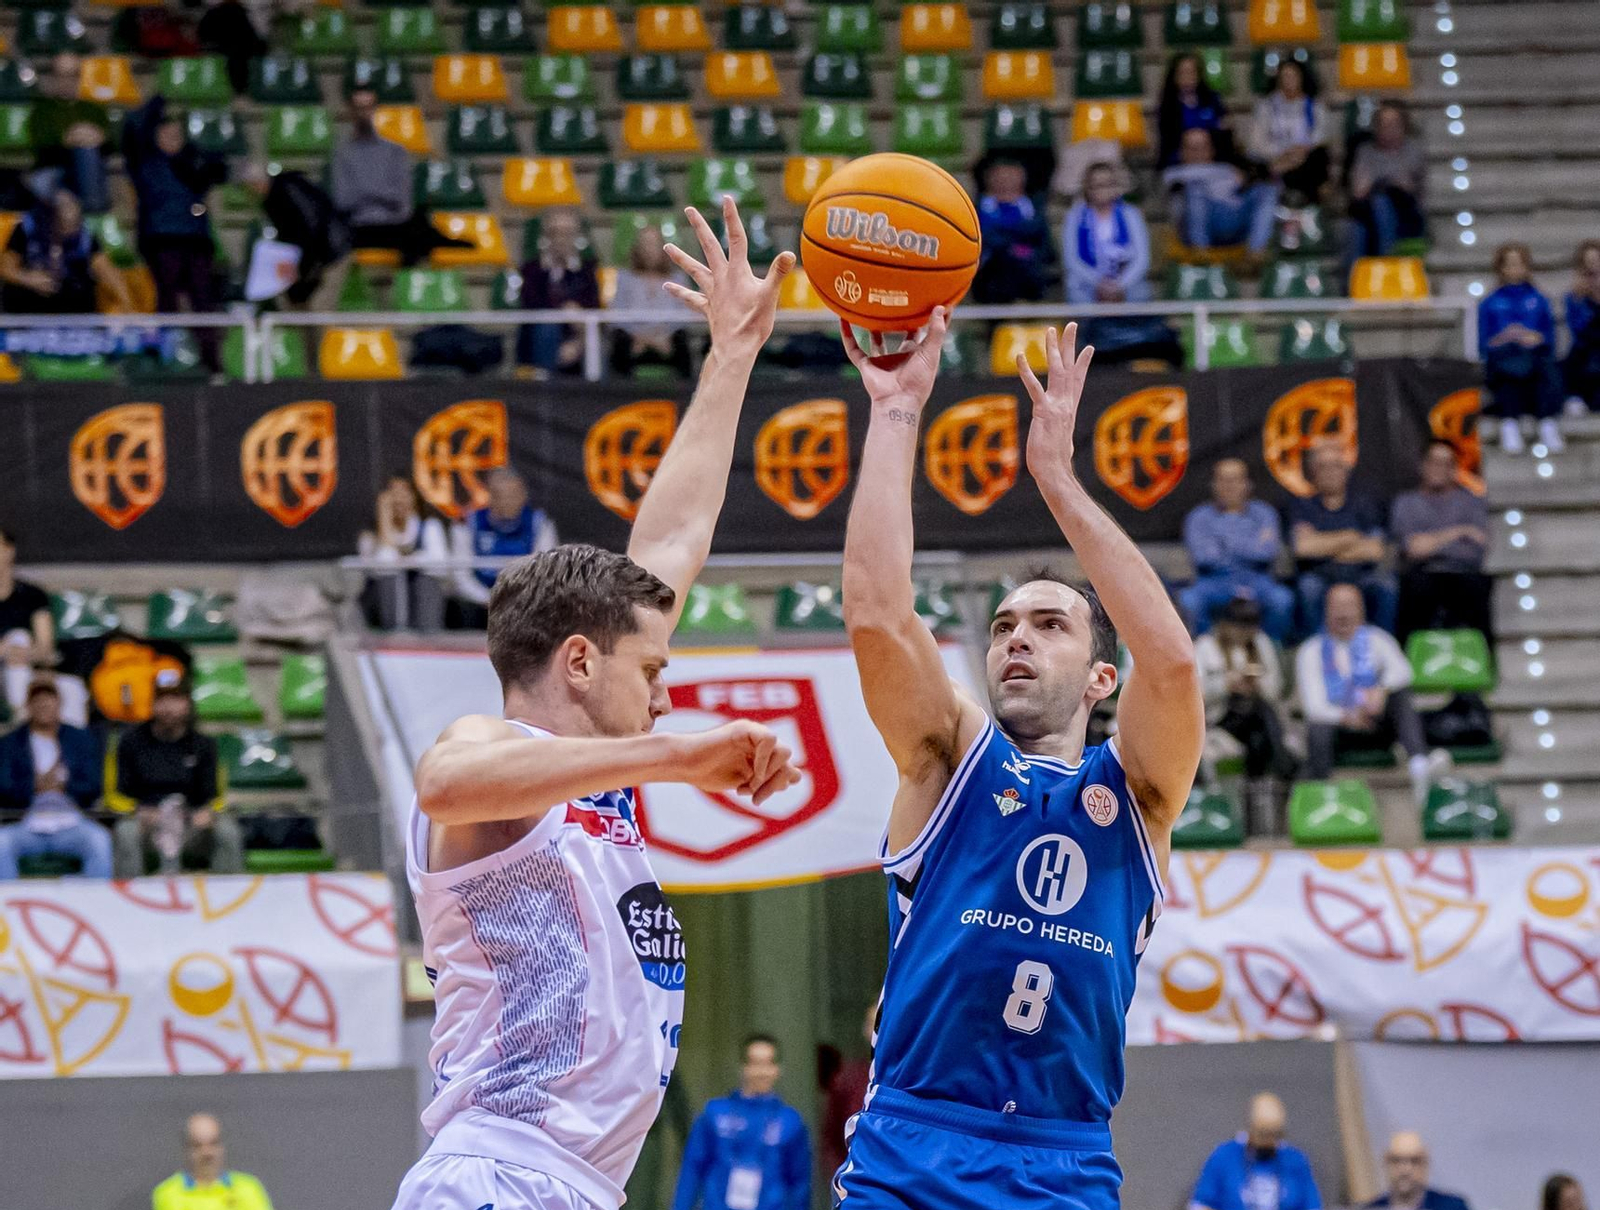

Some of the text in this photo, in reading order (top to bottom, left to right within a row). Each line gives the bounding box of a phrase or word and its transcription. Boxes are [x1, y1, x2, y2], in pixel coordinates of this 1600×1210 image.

[826, 206, 939, 261] Wilson
[699, 682, 800, 710] FEB
[960, 909, 1114, 958] GRUPO HEREDA
[1002, 959, 1055, 1036] 8
